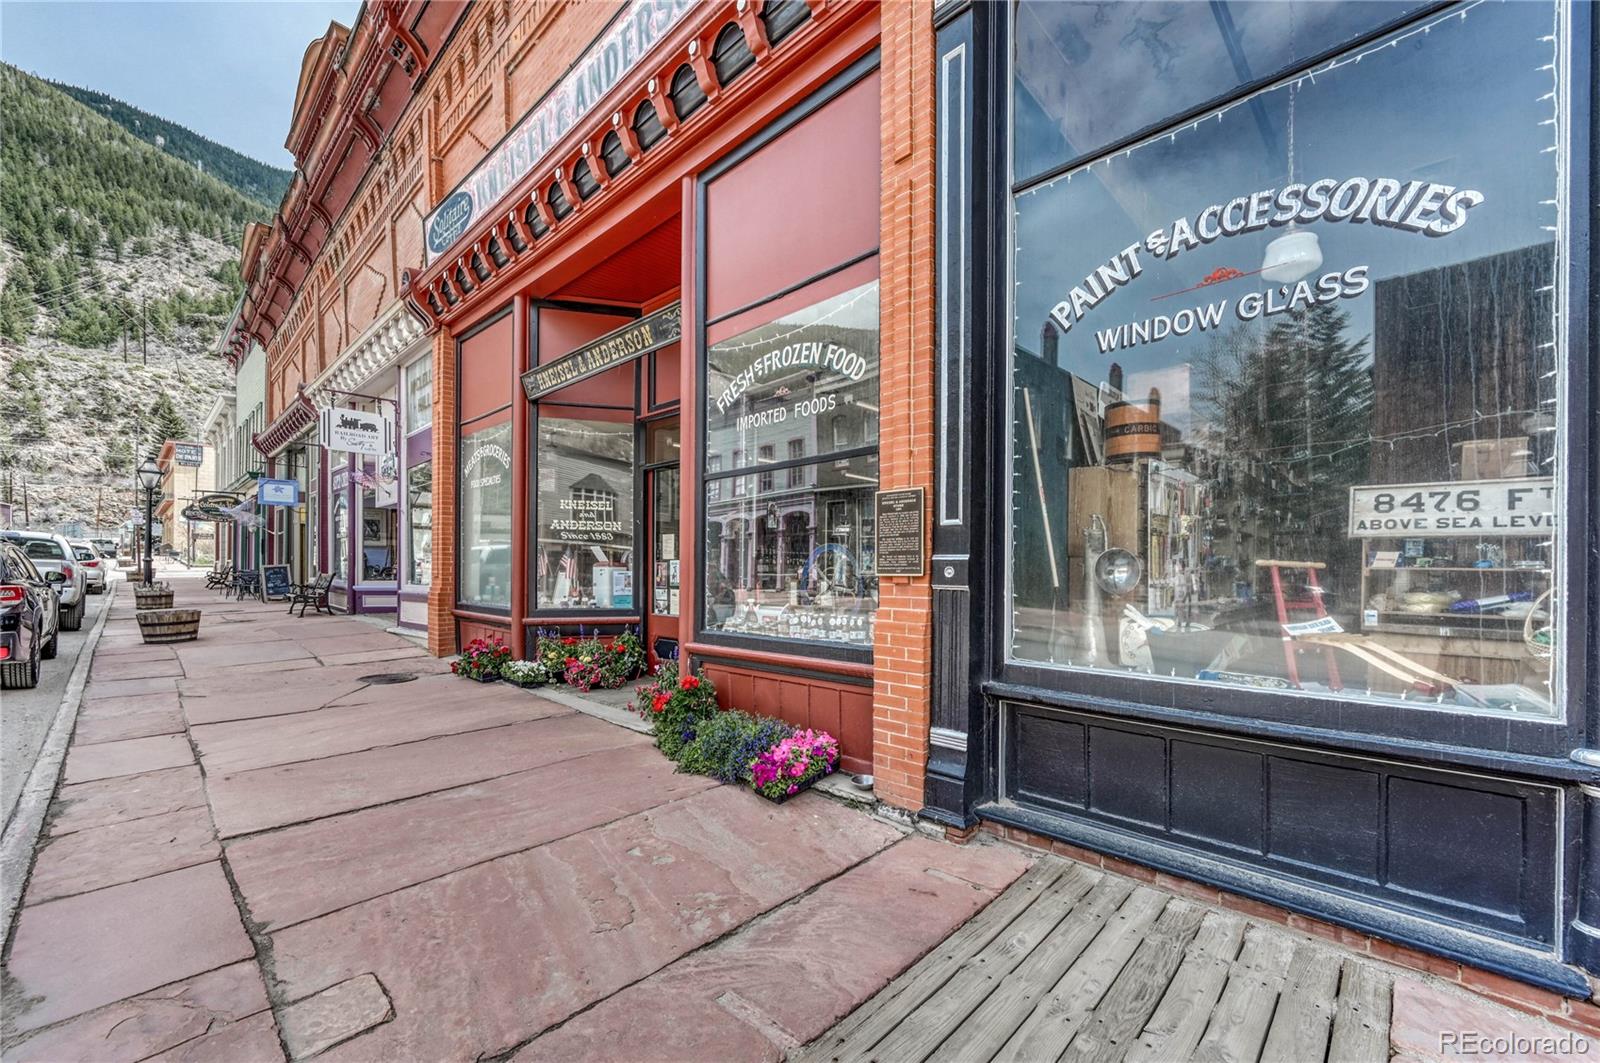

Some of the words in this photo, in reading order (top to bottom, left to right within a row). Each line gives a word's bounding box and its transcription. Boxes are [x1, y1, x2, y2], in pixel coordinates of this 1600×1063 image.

[575, 0, 690, 118] ANDERS
[433, 197, 470, 242] Solitaire
[1050, 241, 1142, 334] PAINT
[1165, 177, 1485, 260] ACCESSORIES
[1097, 300, 1227, 354] WINDOW
[1236, 265, 1370, 321] GLASS
[537, 360, 577, 390] KNEISEL
[587, 324, 653, 370] ANDERSON
[716, 365, 755, 414] FRESH
[763, 342, 823, 374] FROZEN
[823, 344, 867, 381] FOOD
[736, 406, 787, 432] IMPORTED
[794, 394, 836, 418] FOODS
[560, 499, 613, 511] KNEISEL
[1374, 489, 1480, 514] 8476
[550, 519, 622, 531] ANDERSON
[560, 531, 589, 540] Since
[590, 532, 614, 541] 1883
[1357, 518, 1428, 531] ABOVE
[1436, 516, 1482, 529] SEA
